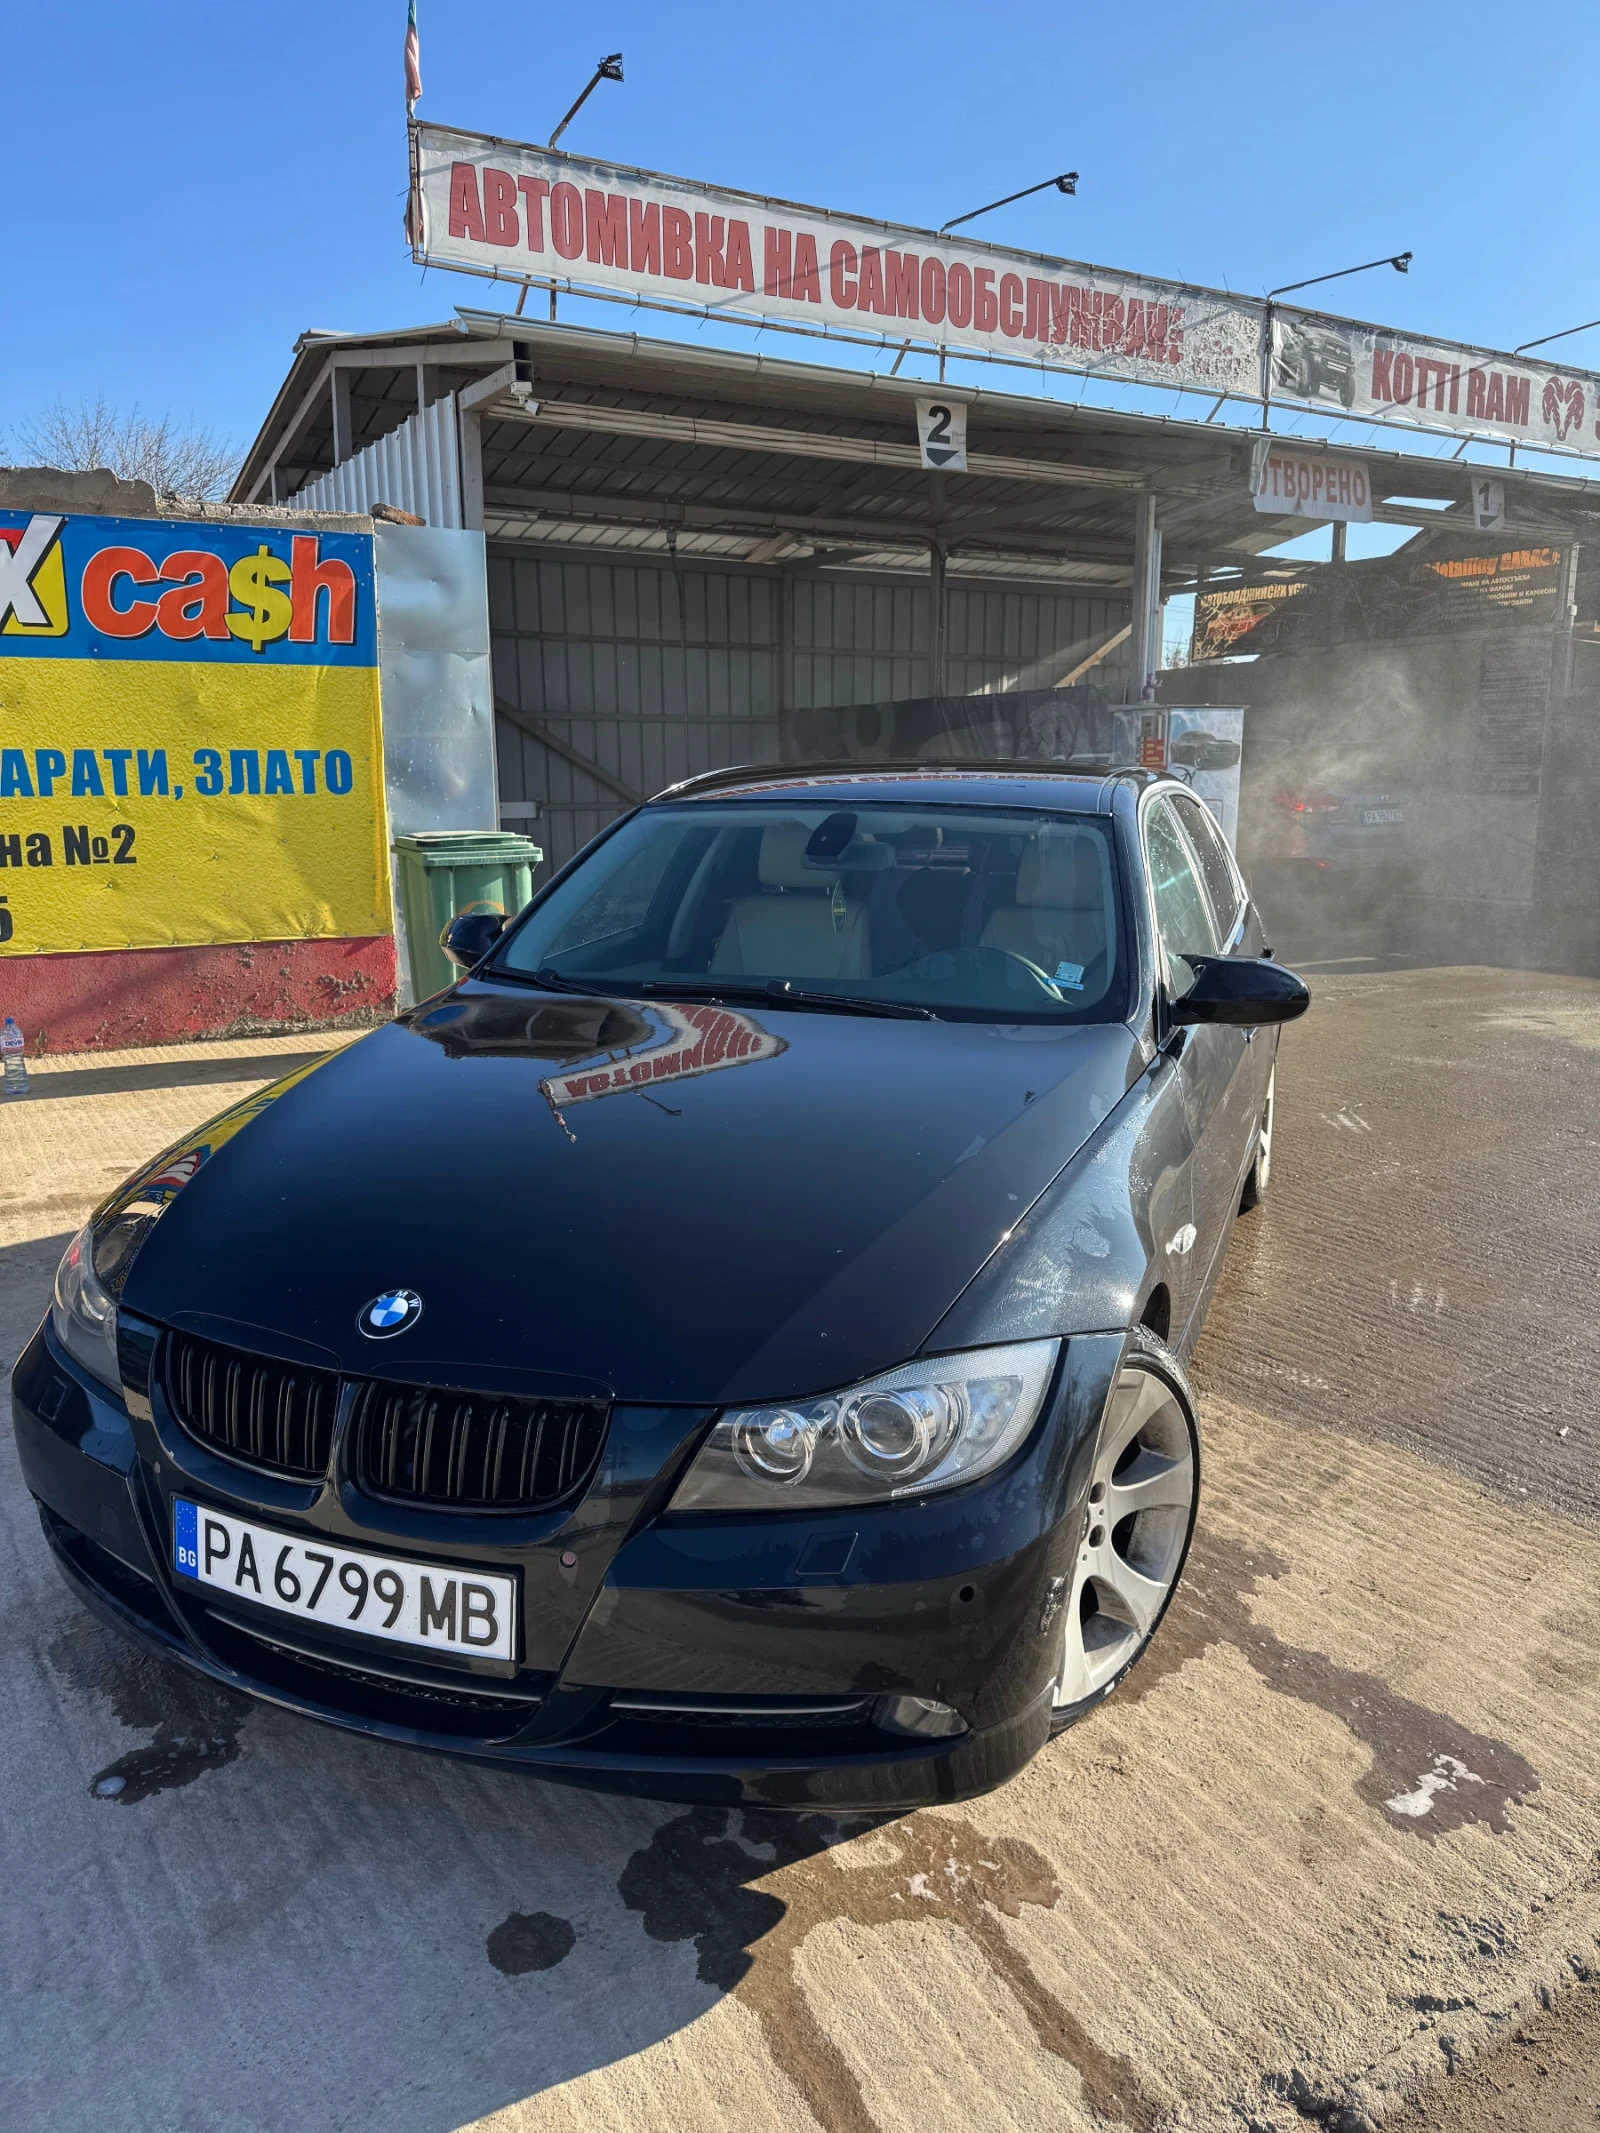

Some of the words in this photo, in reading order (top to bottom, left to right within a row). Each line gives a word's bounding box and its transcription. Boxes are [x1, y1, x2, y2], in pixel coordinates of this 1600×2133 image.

[449, 161, 755, 293] АВТОМИВКА
[764, 226, 822, 304] НА
[1371, 348, 1460, 414] KOTTI
[1466, 367, 1530, 426] RAM
[927, 405, 951, 444] 2
[1478, 482, 1490, 511] 1
[81, 535, 356, 652] ca$h
[0, 748, 184, 800] АРАТИ,
[193, 749, 354, 796] ЗЛАТО
[63, 823, 137, 866] №2
[377, 1290, 420, 1308] BMW
[178, 1545, 196, 1568] BG
